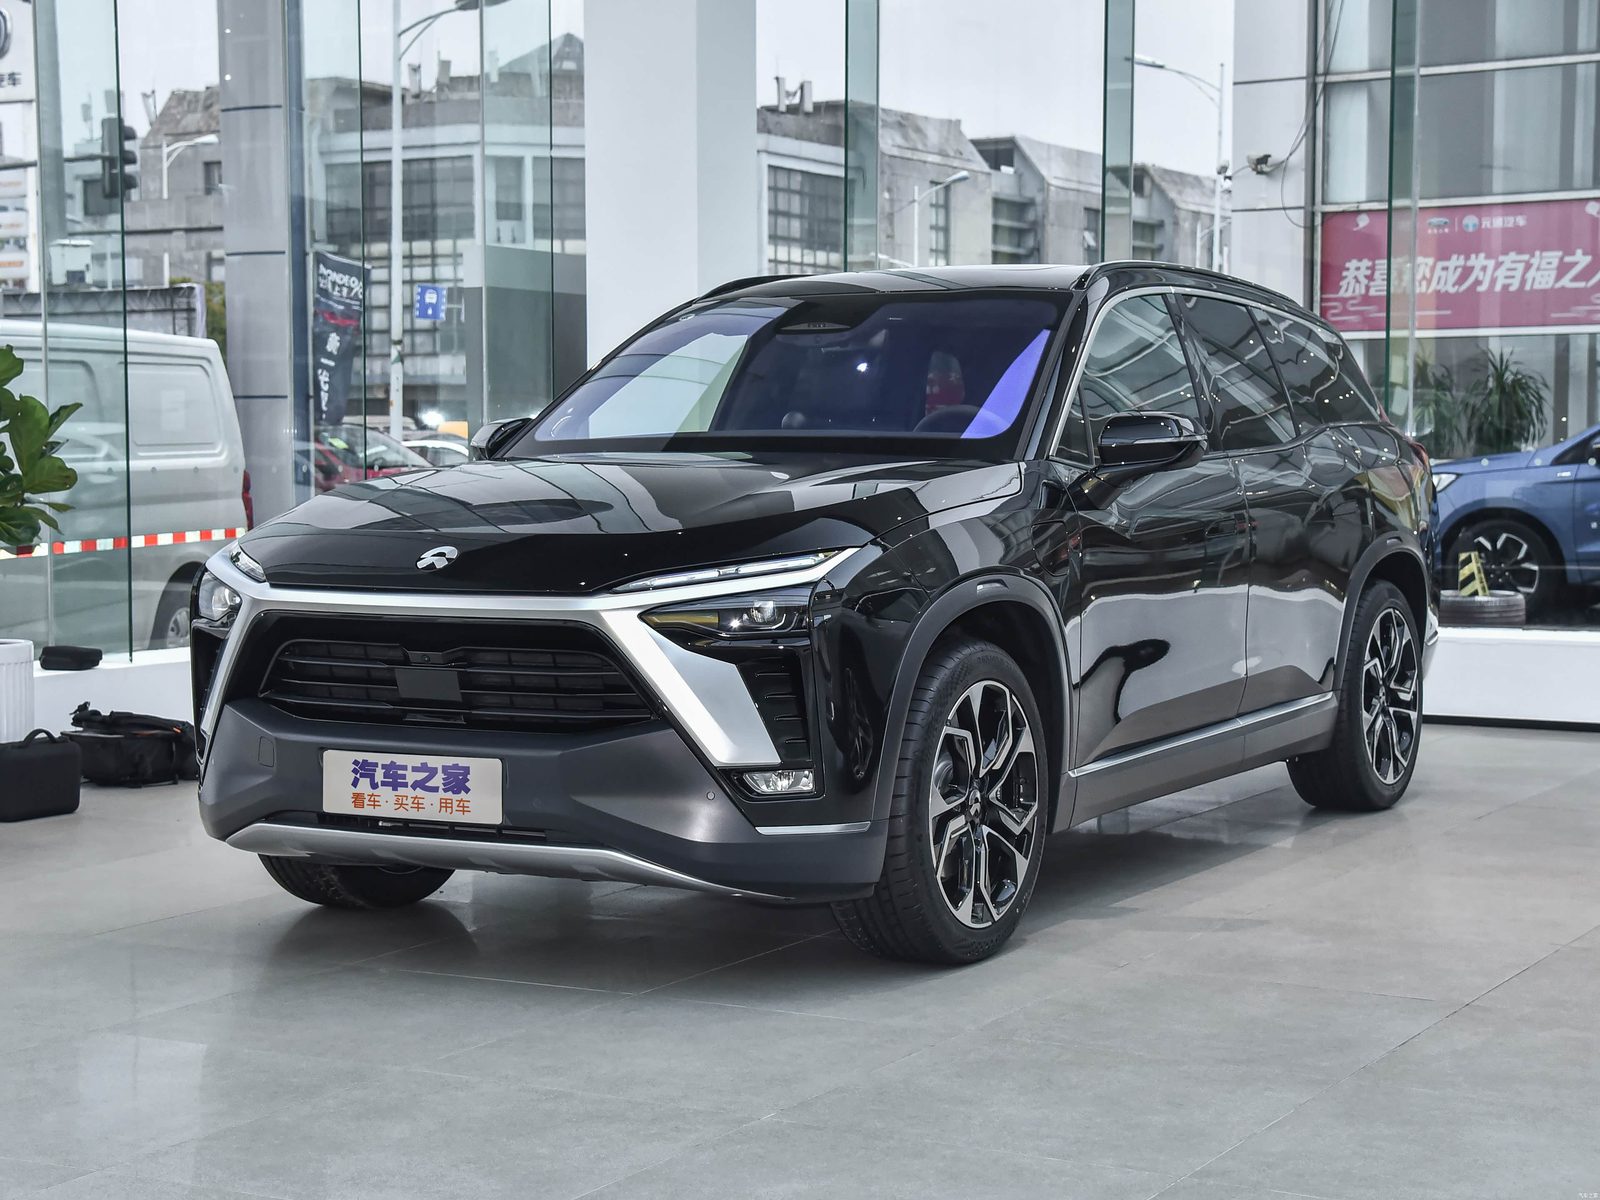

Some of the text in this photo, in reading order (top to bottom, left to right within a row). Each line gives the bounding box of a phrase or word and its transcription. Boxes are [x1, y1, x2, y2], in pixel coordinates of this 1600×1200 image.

[1337, 248, 1600, 298] 恭喜您成为有福之
[351, 759, 471, 795] 汽车之家
